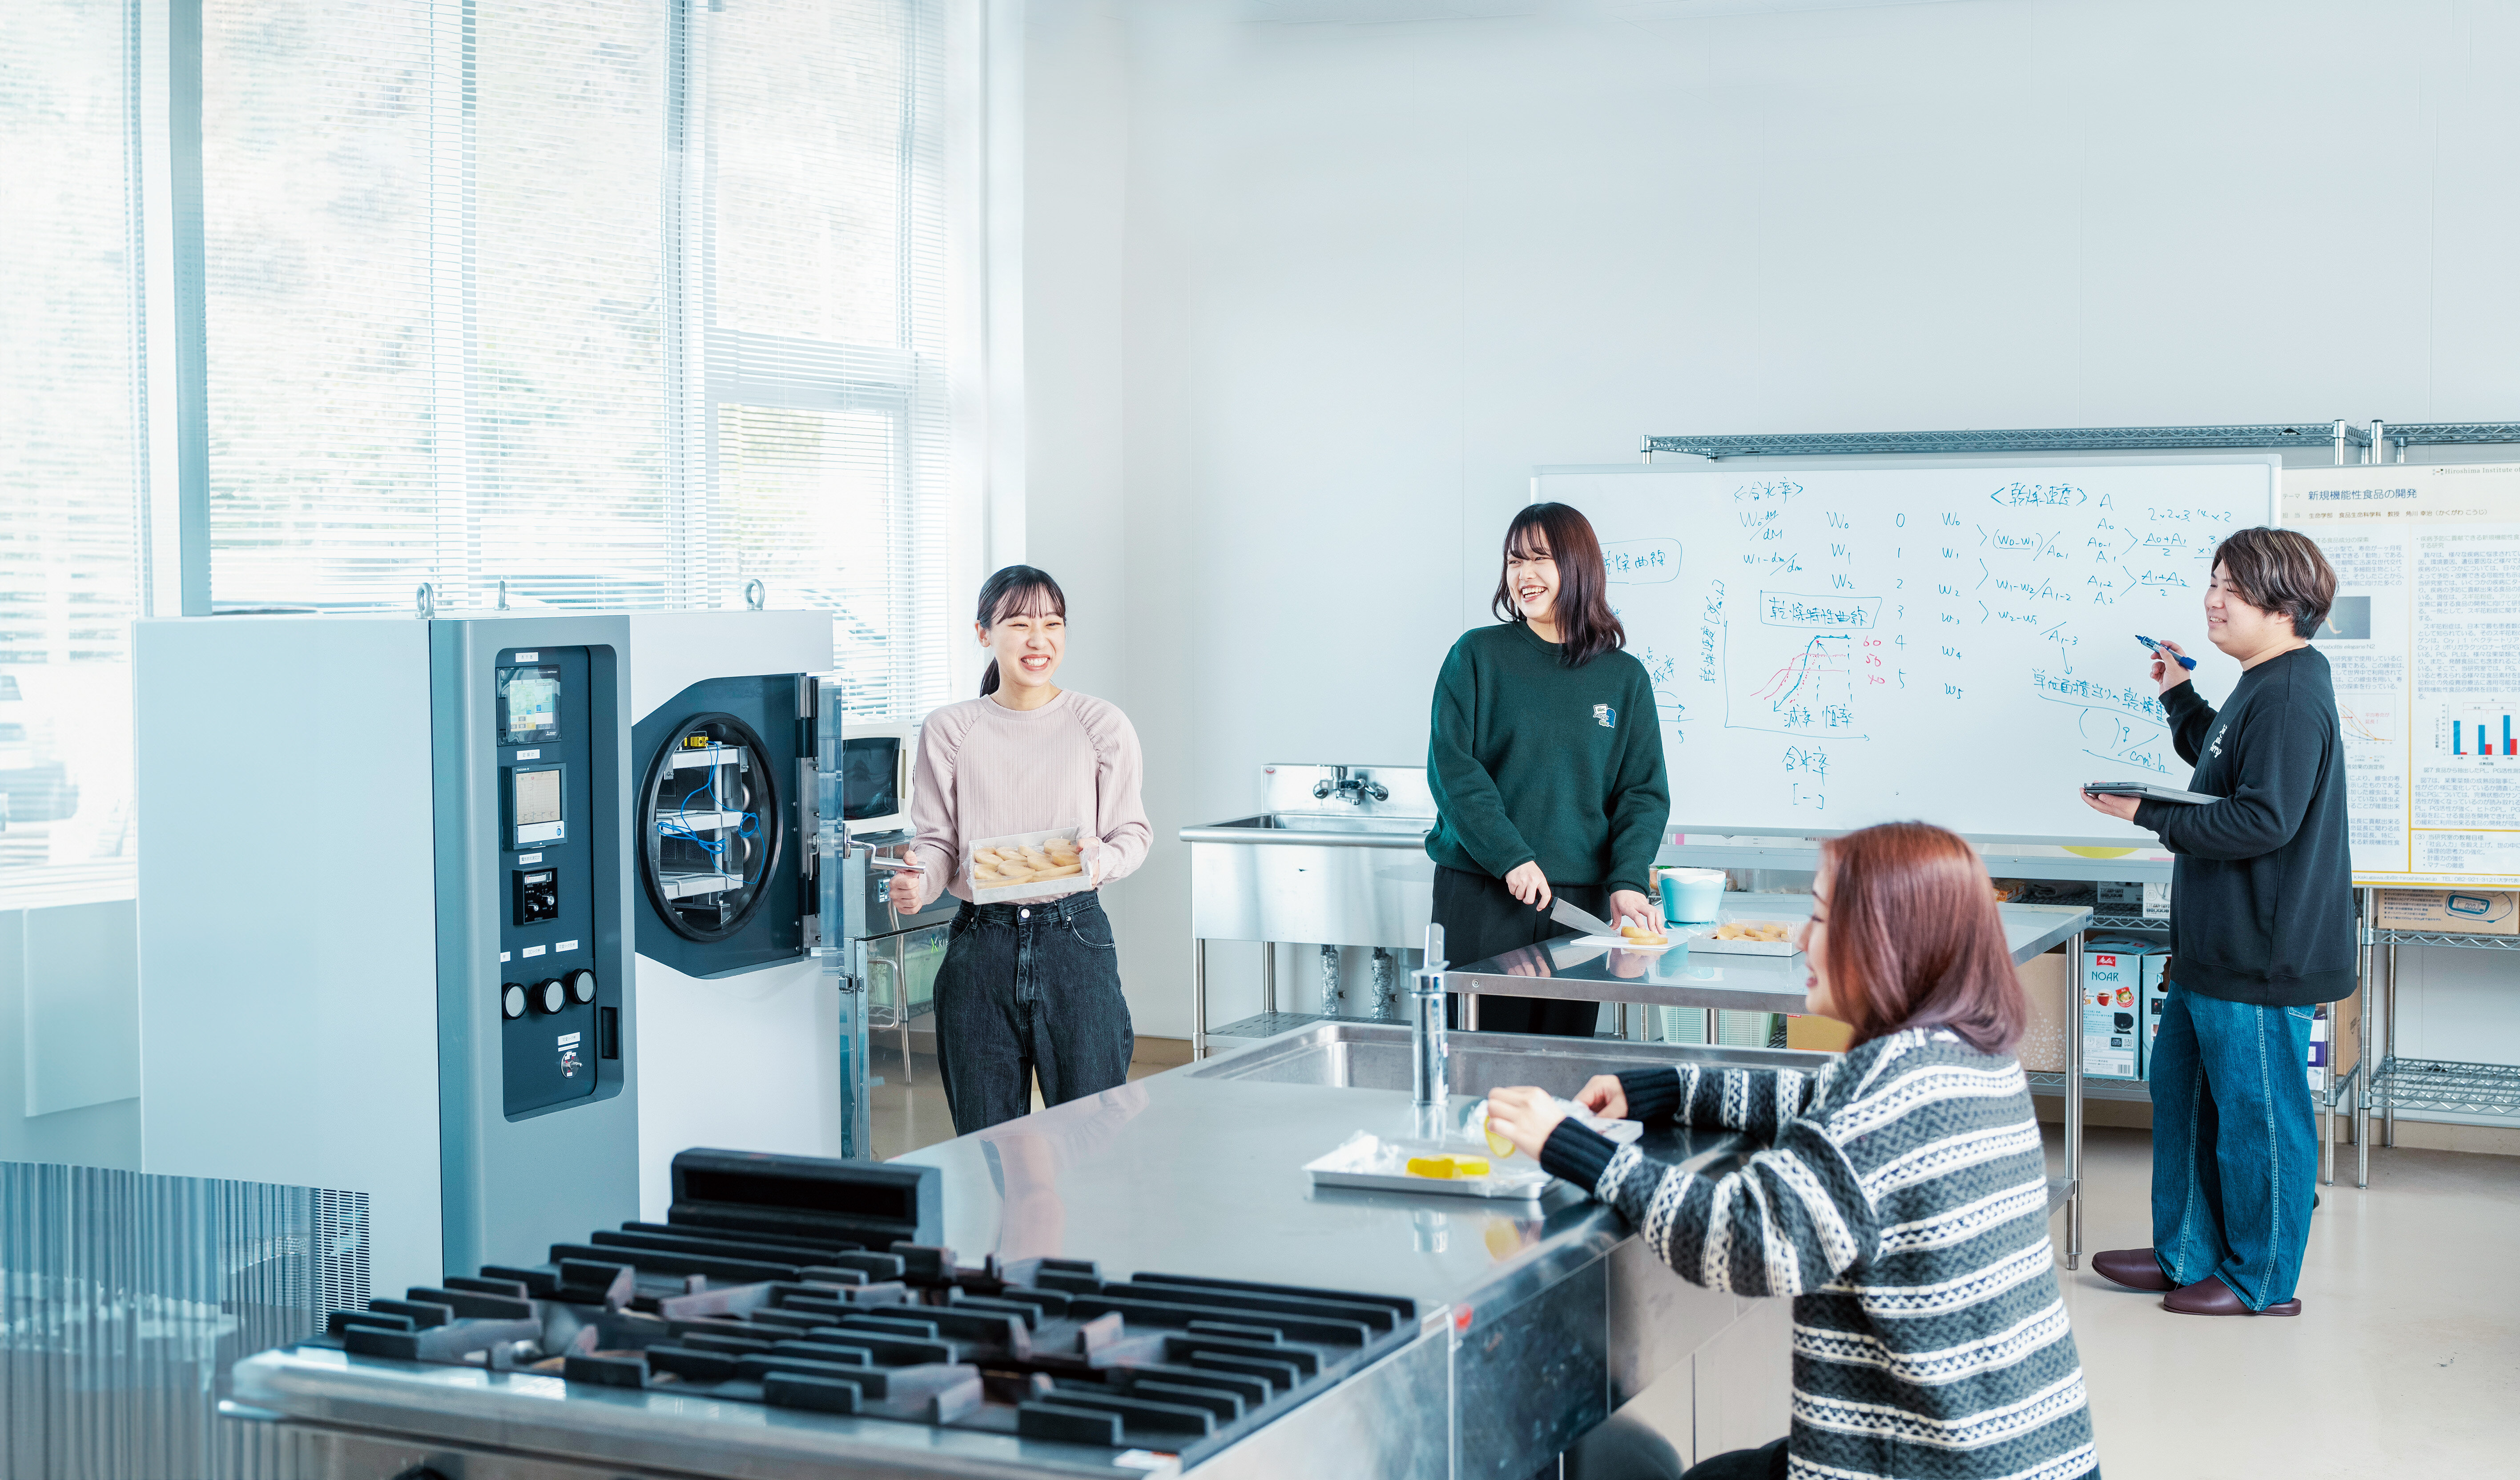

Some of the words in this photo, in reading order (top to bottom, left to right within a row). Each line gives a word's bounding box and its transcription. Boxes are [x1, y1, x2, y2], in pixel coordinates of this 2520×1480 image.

[2308, 488, 2417, 501] 新規機能性食品の開発
[1768, 597, 1868, 627] 乾燥特性曲線
[1863, 635, 1881, 647] 60
[2092, 971, 2119, 982] NOAR
